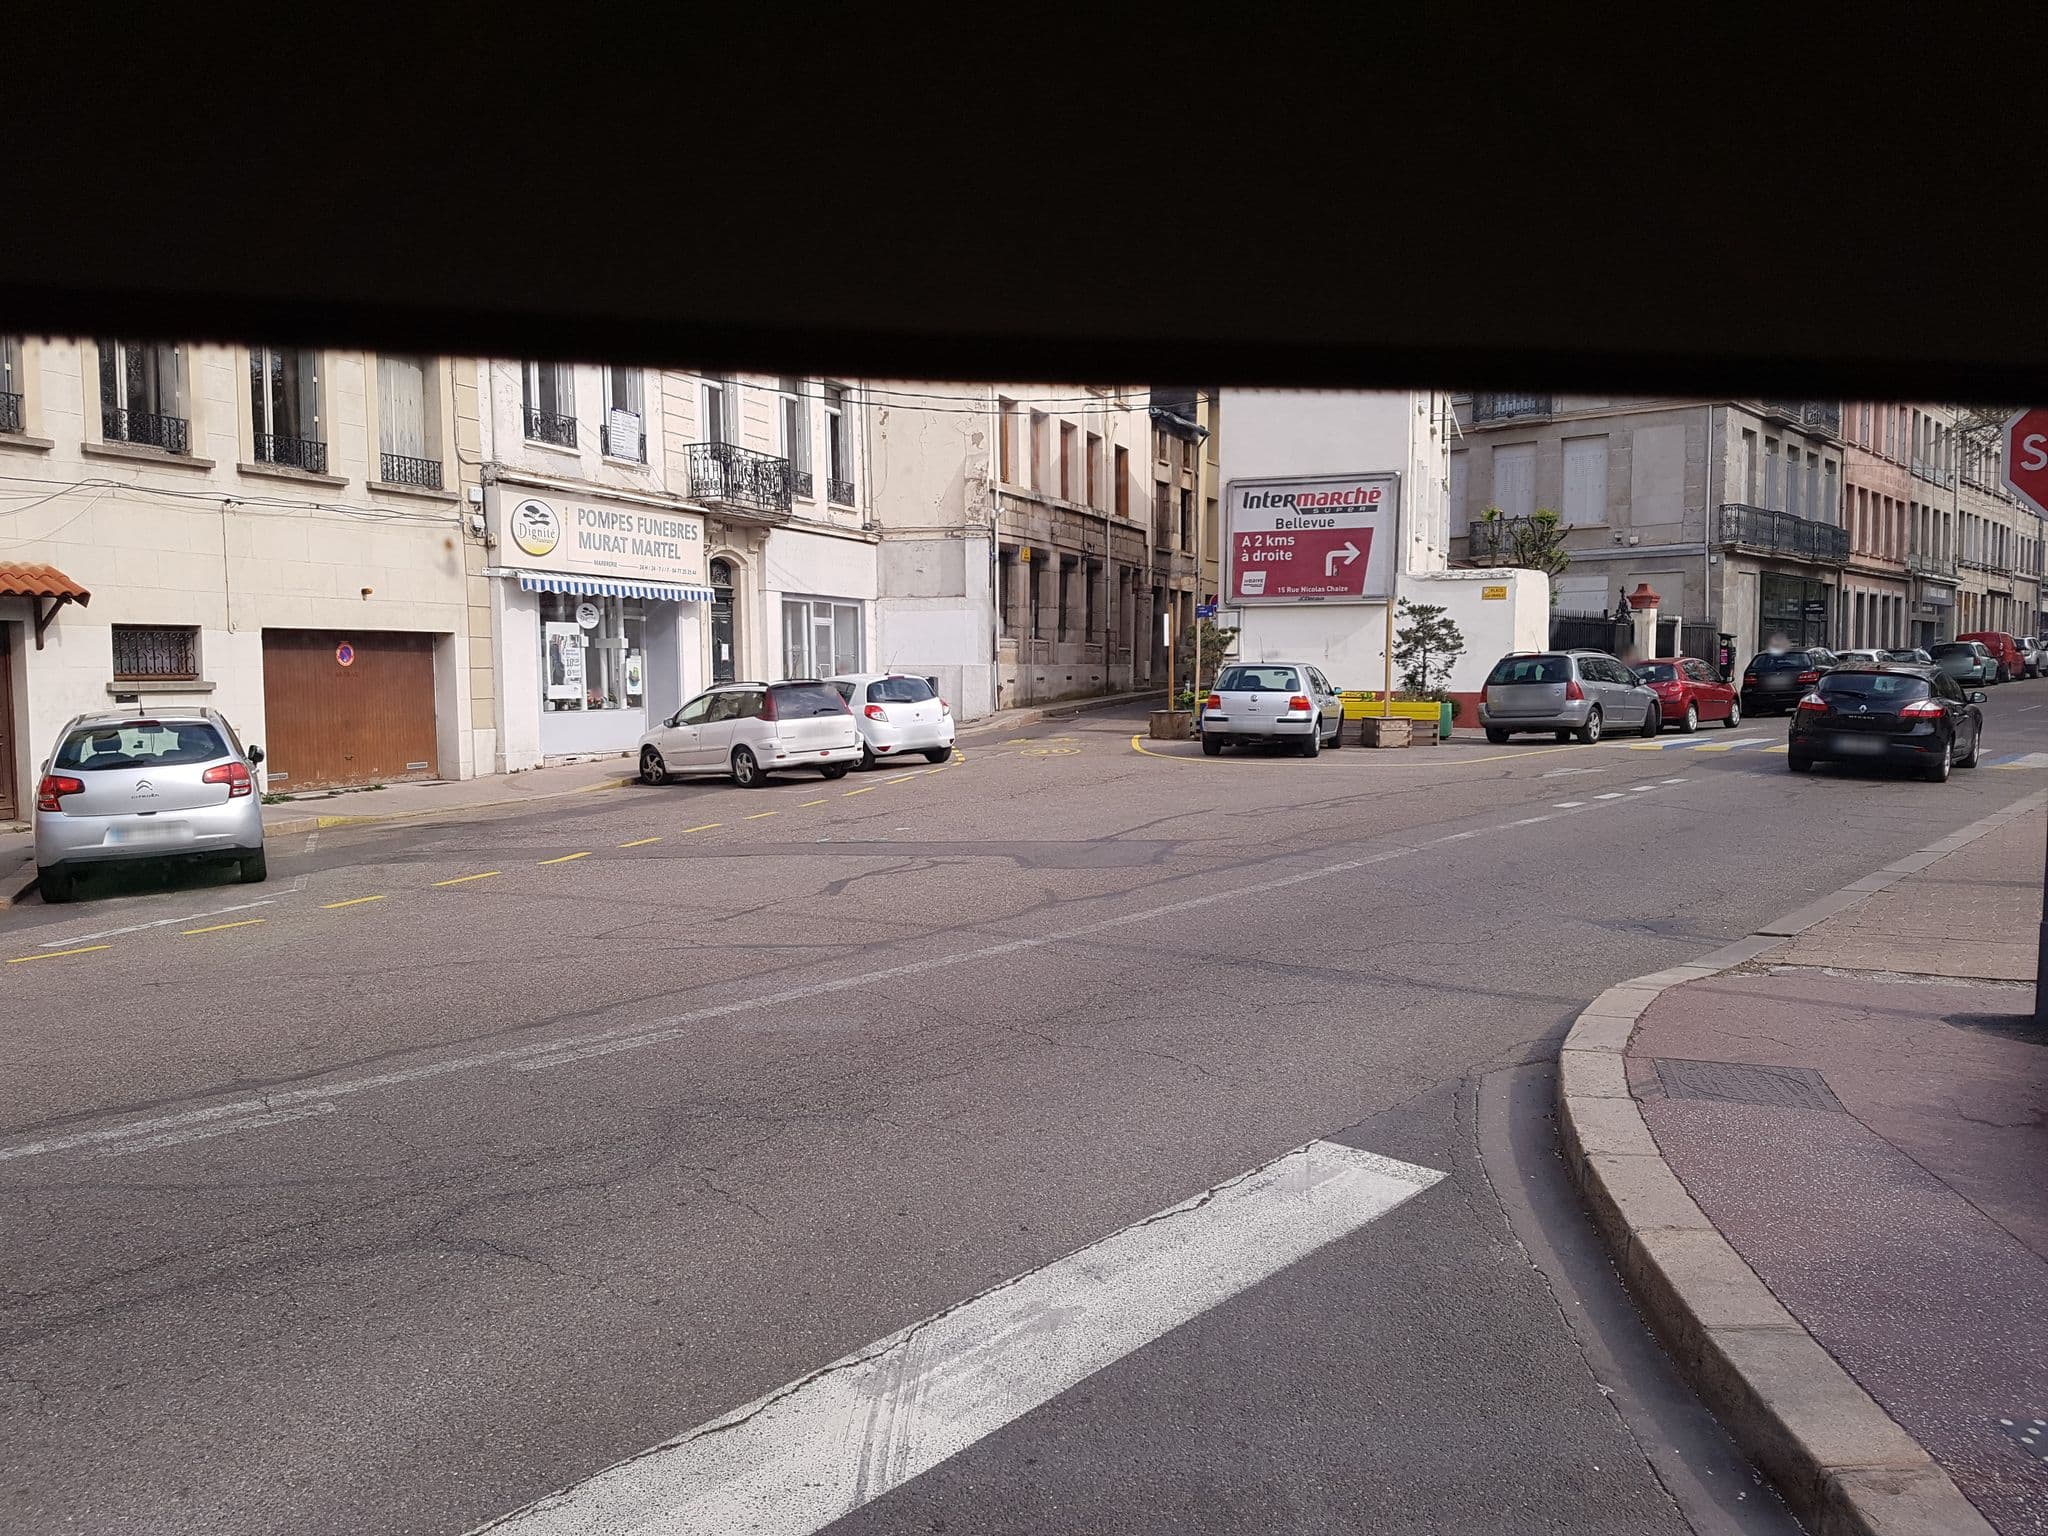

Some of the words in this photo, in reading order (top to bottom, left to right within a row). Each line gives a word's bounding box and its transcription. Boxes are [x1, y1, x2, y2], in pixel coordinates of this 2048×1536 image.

[1243, 487, 1382, 515] Intermarché
[518, 522, 557, 541] Dignité
[578, 508, 633, 532] POMPES
[637, 517, 697, 541] FUNEBRES
[1275, 518, 1335, 530] Bellevue
[579, 531, 629, 554] MURAT
[632, 538, 681, 560] MARTEL
[1241, 535, 1251, 547] A
[1254, 535, 1263, 547] 2
[1266, 535, 1296, 546] kms
[1241, 549, 1249, 561] à
[1252, 549, 1293, 561] droite
